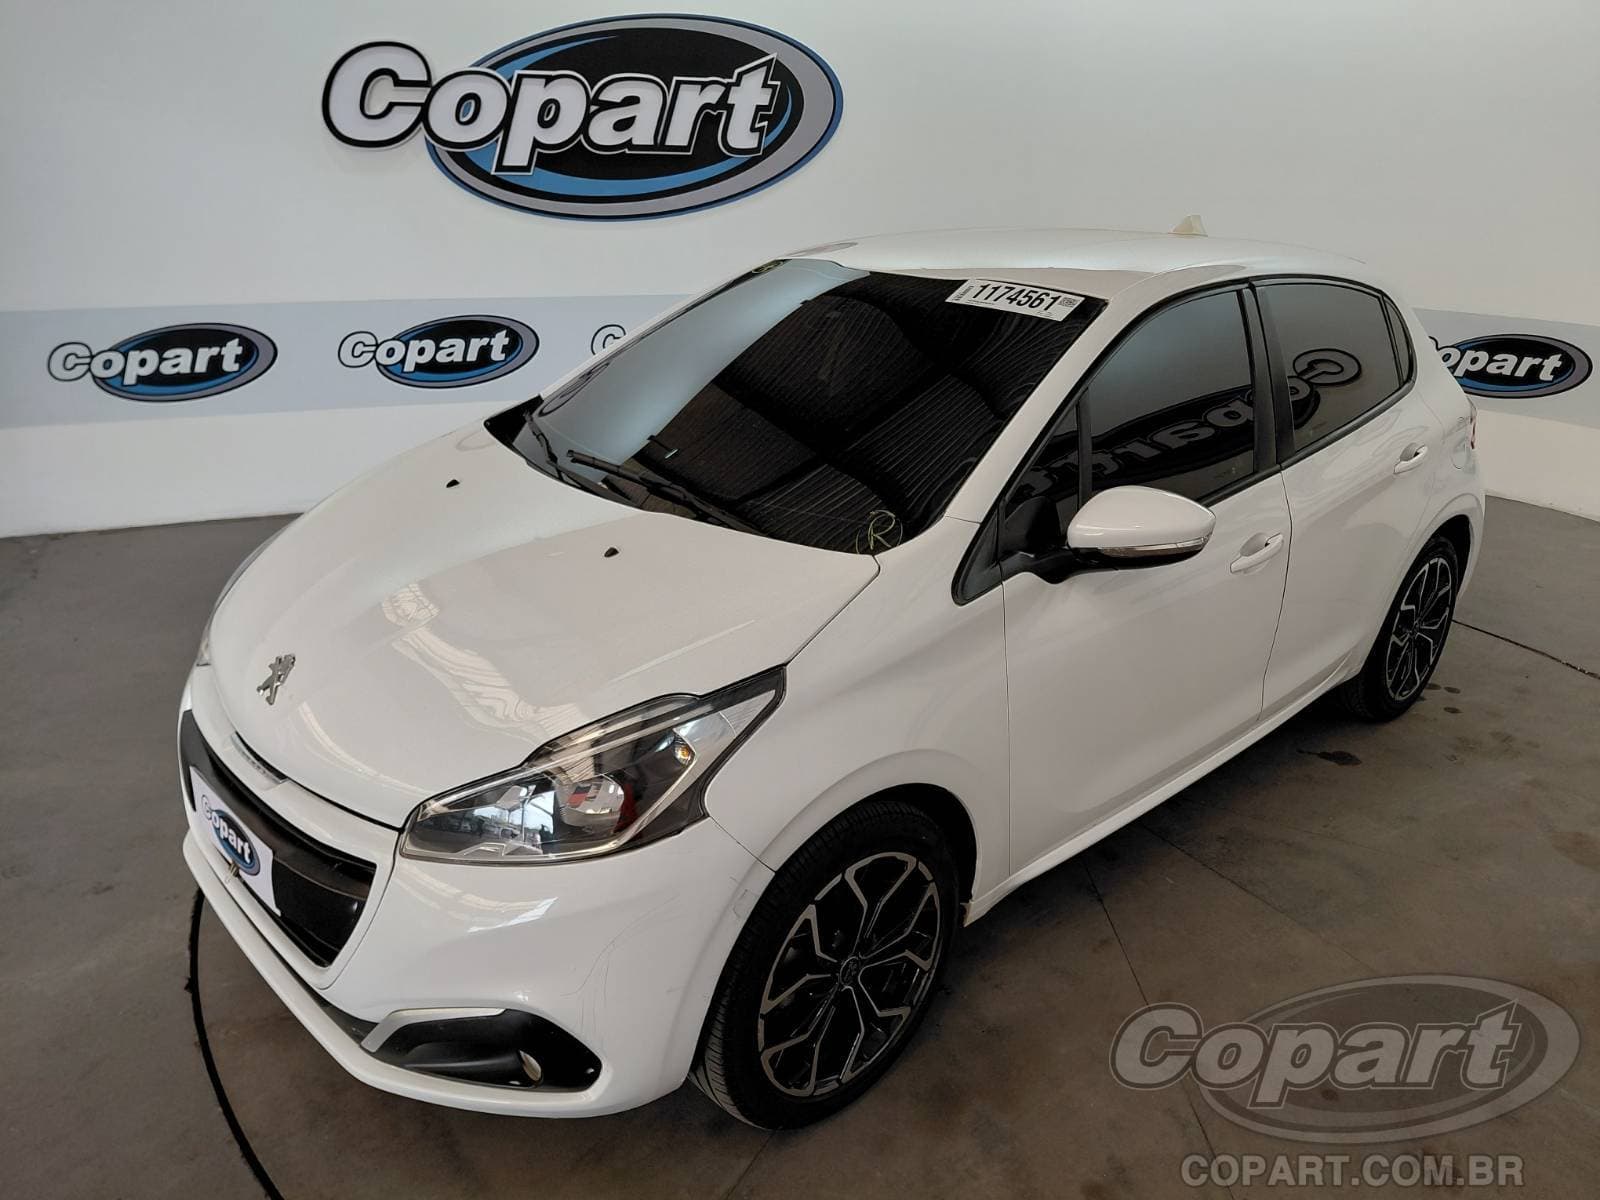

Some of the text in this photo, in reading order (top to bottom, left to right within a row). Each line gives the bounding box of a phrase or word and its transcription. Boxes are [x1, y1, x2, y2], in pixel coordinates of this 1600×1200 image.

[322, 41, 782, 175] Copart
[972, 283, 1062, 311] 1174561
[47, 337, 243, 386] Copart
[338, 329, 510, 369] Copart
[1430, 338, 1563, 382] opart
[201, 794, 251, 864] Copart
